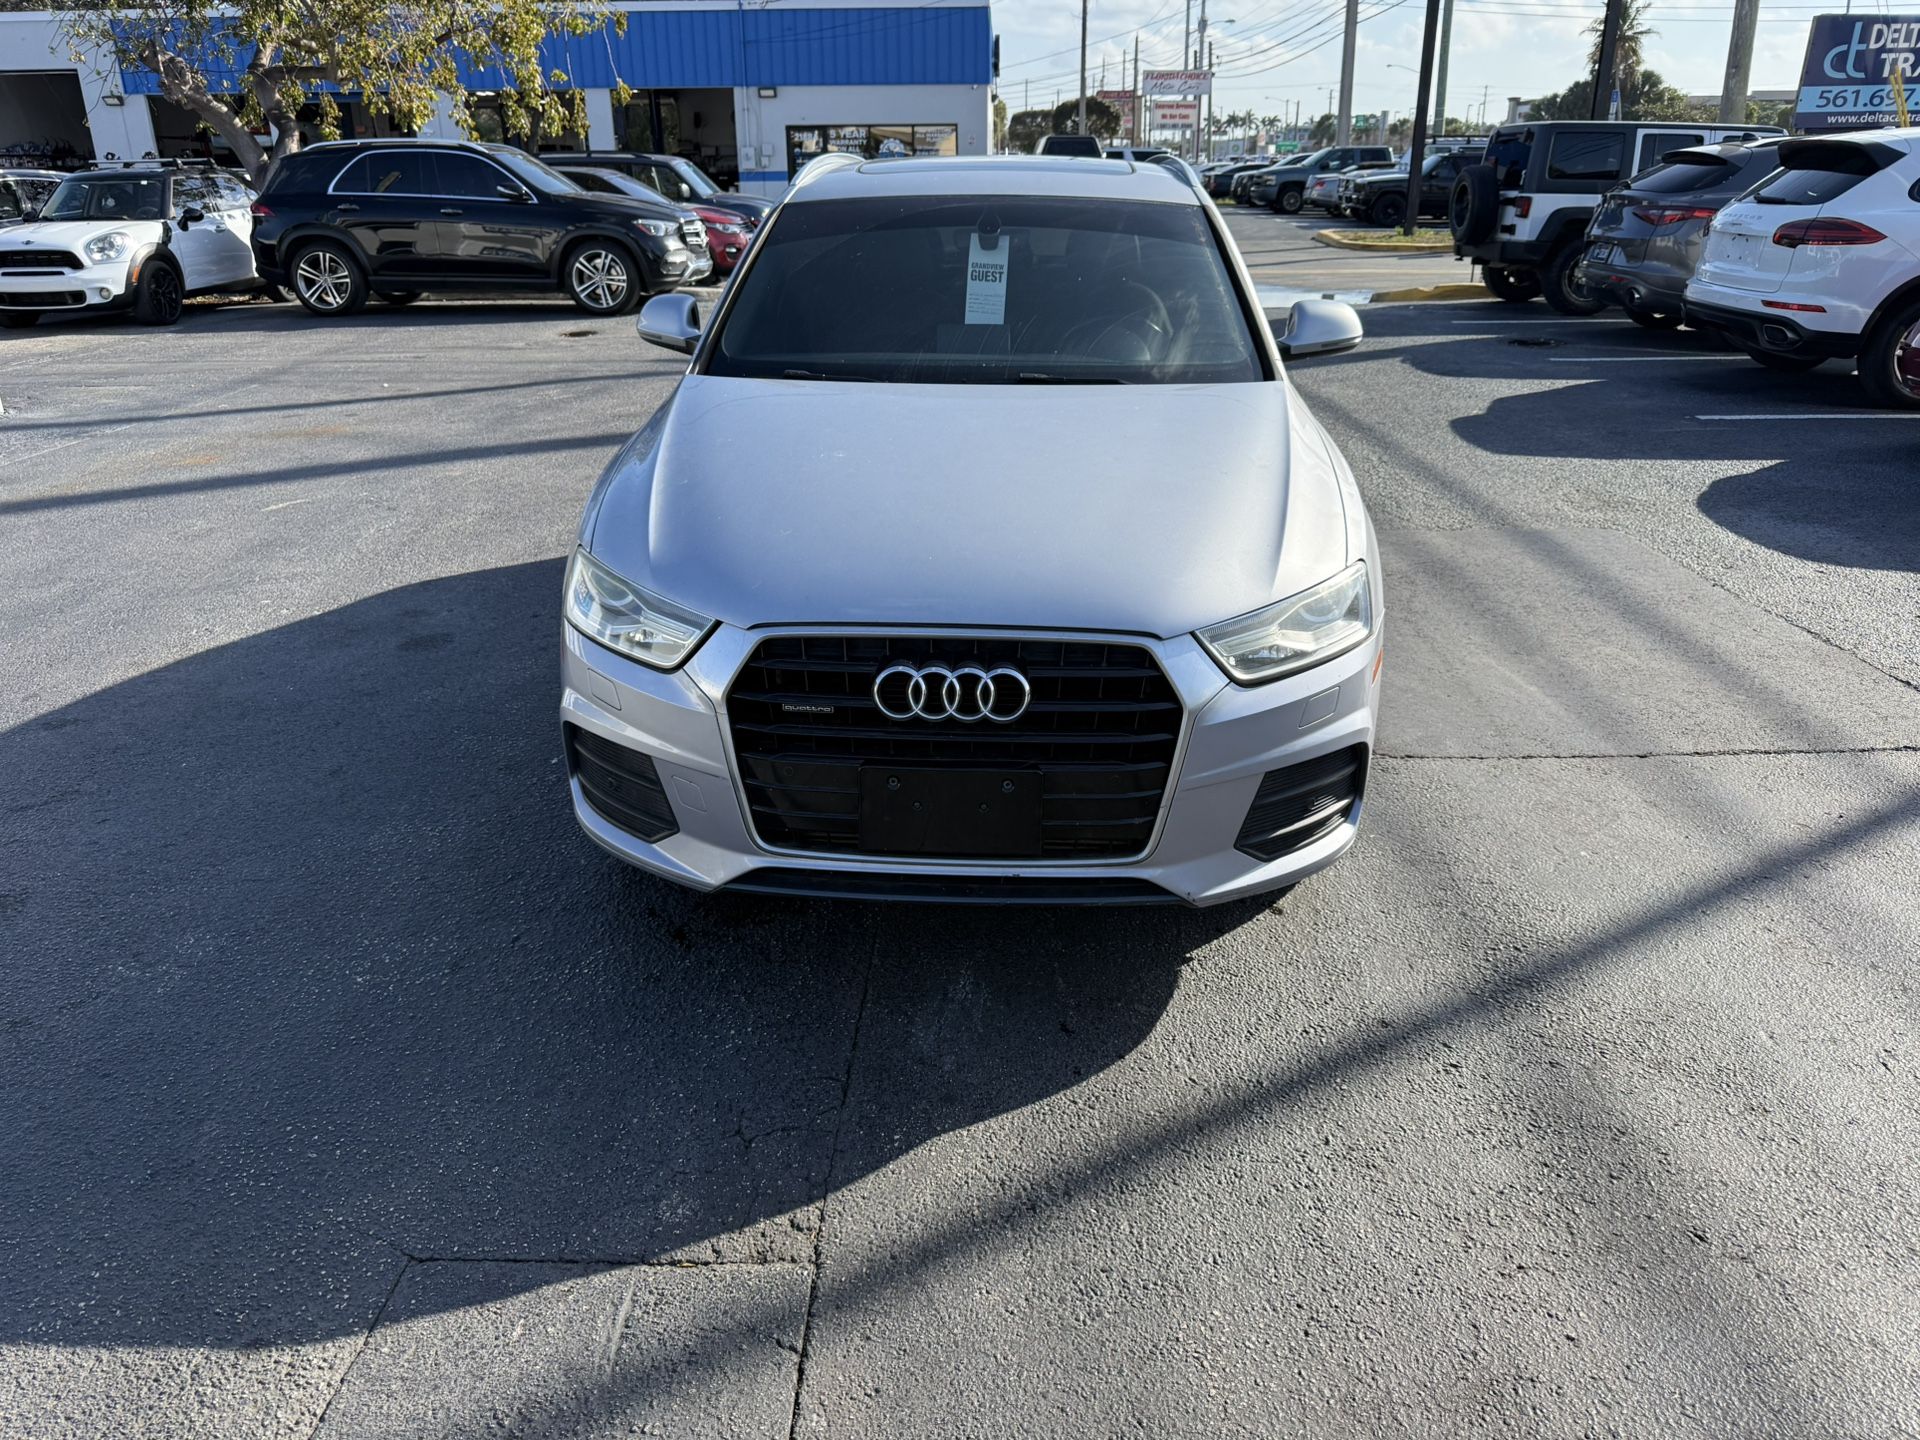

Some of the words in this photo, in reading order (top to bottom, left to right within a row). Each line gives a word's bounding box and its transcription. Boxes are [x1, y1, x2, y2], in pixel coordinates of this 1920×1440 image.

[1868, 23, 1920, 48] DELT
[1880, 52, 1920, 78] TR
[1179, 71, 1209, 80] CHOICE
[1827, 112, 1920, 123] www.deltacatra
[839, 128, 866, 138] YEAR
[971, 262, 1004, 270] GRANDVIEW
[970, 269, 1004, 283] GUEST
